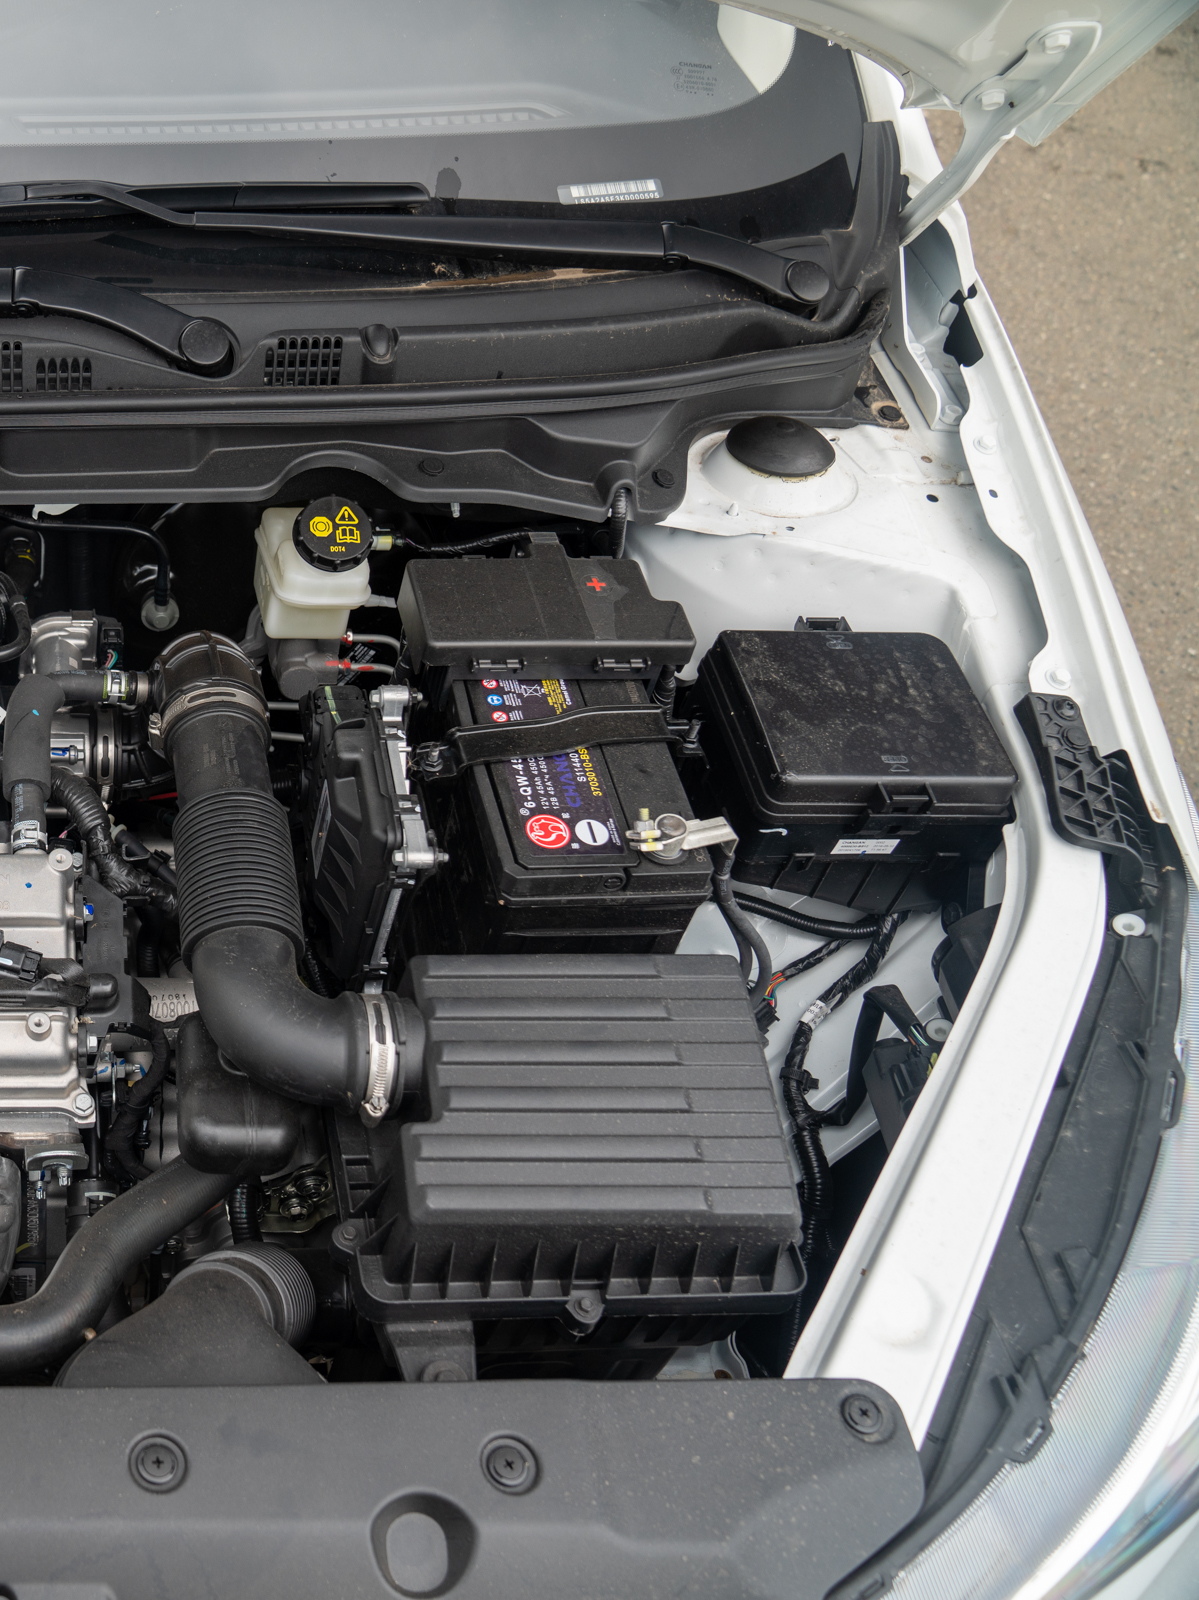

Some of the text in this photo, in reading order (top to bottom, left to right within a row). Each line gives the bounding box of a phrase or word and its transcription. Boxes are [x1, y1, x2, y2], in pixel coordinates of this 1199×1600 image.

[569, 753, 586, 782] S11440
[534, 776, 545, 794] 45Ah
[540, 796, 550, 810] 12V
